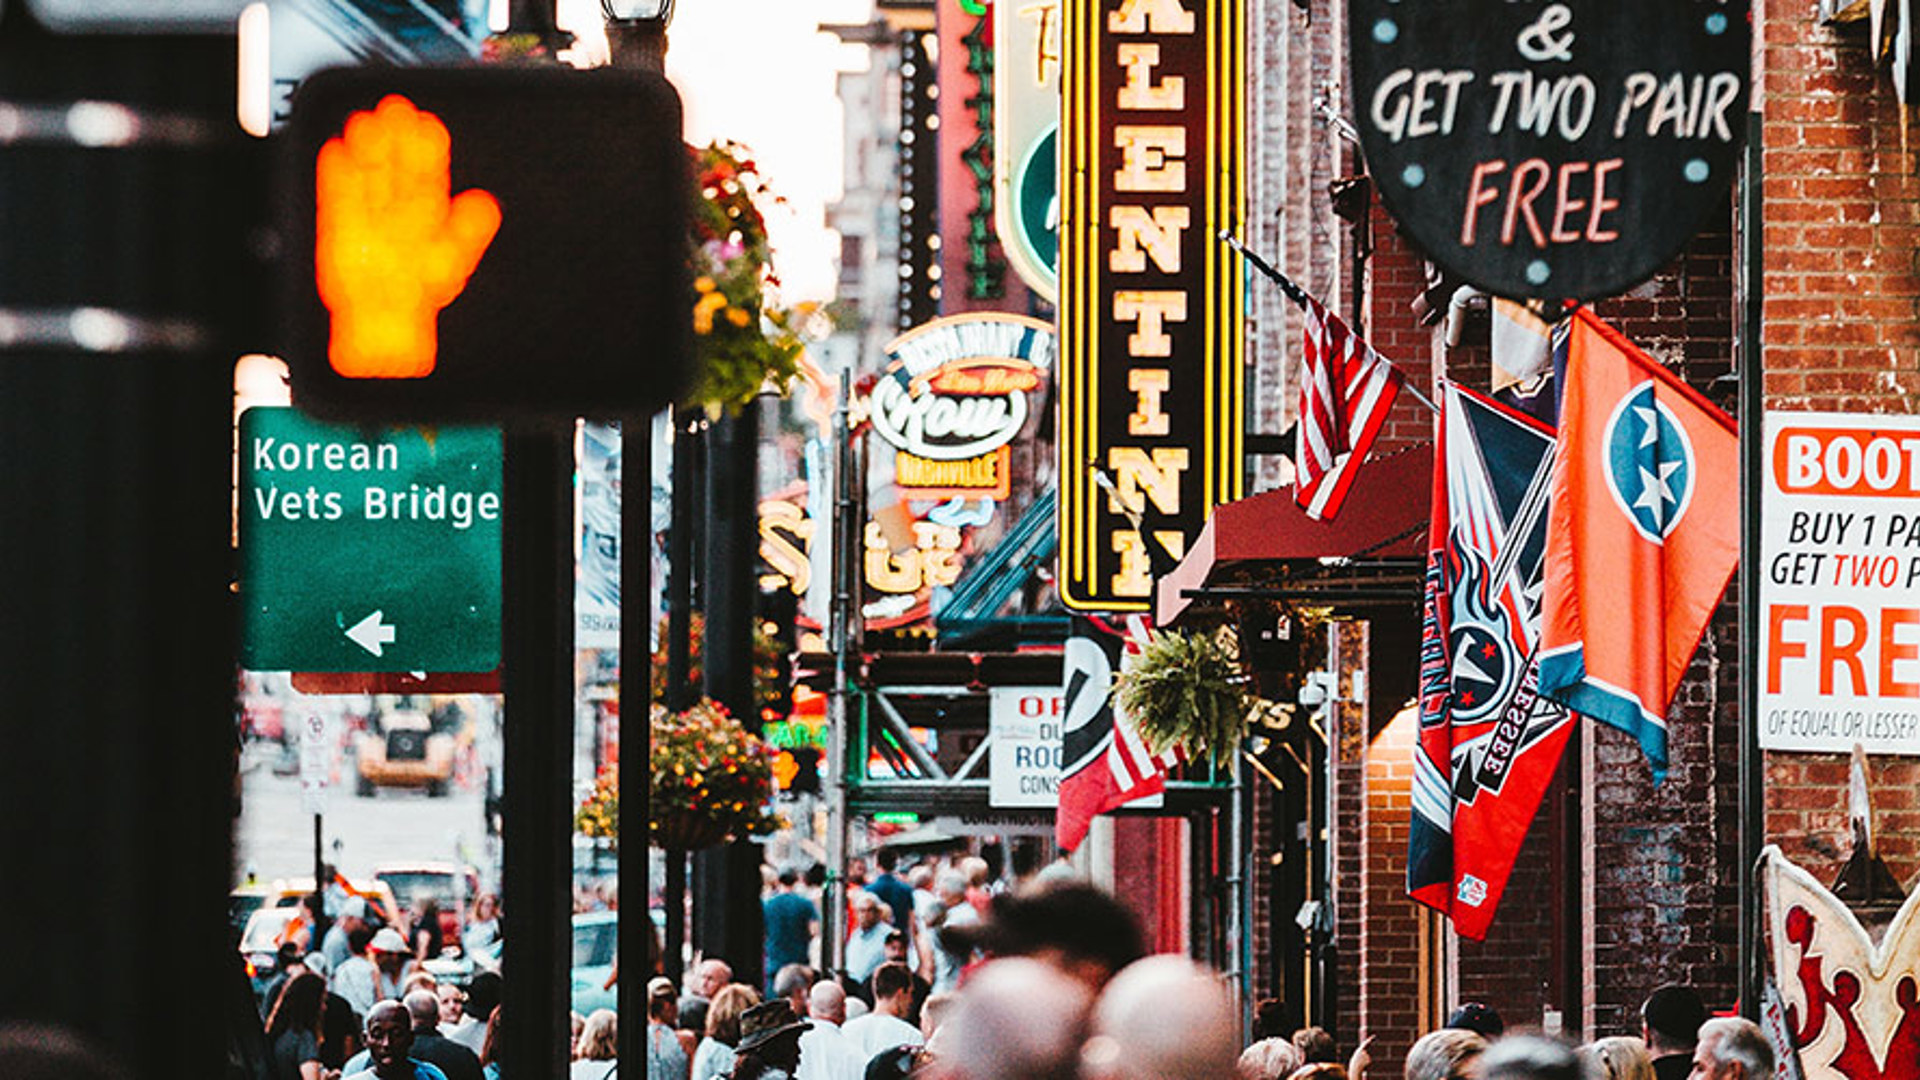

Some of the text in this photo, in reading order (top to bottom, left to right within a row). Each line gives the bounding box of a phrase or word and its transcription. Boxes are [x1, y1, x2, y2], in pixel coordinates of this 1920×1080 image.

[1517, 3, 1574, 61] &
[1371, 69, 1740, 142] GET TWO PAIR
[1460, 157, 1624, 248] FREE
[253, 438, 398, 470] Korean
[1787, 434, 1920, 491] BOOT
[254, 484, 500, 529] Vets Bridge
[1789, 511, 1854, 546] BUY
[1862, 515, 1876, 546] 1
[1771, 552, 1827, 586] GET
[1833, 554, 1899, 588] TWO
[1767, 604, 1920, 698] FRE
[1768, 710, 1918, 739] OF EQUAL OR LESSER
